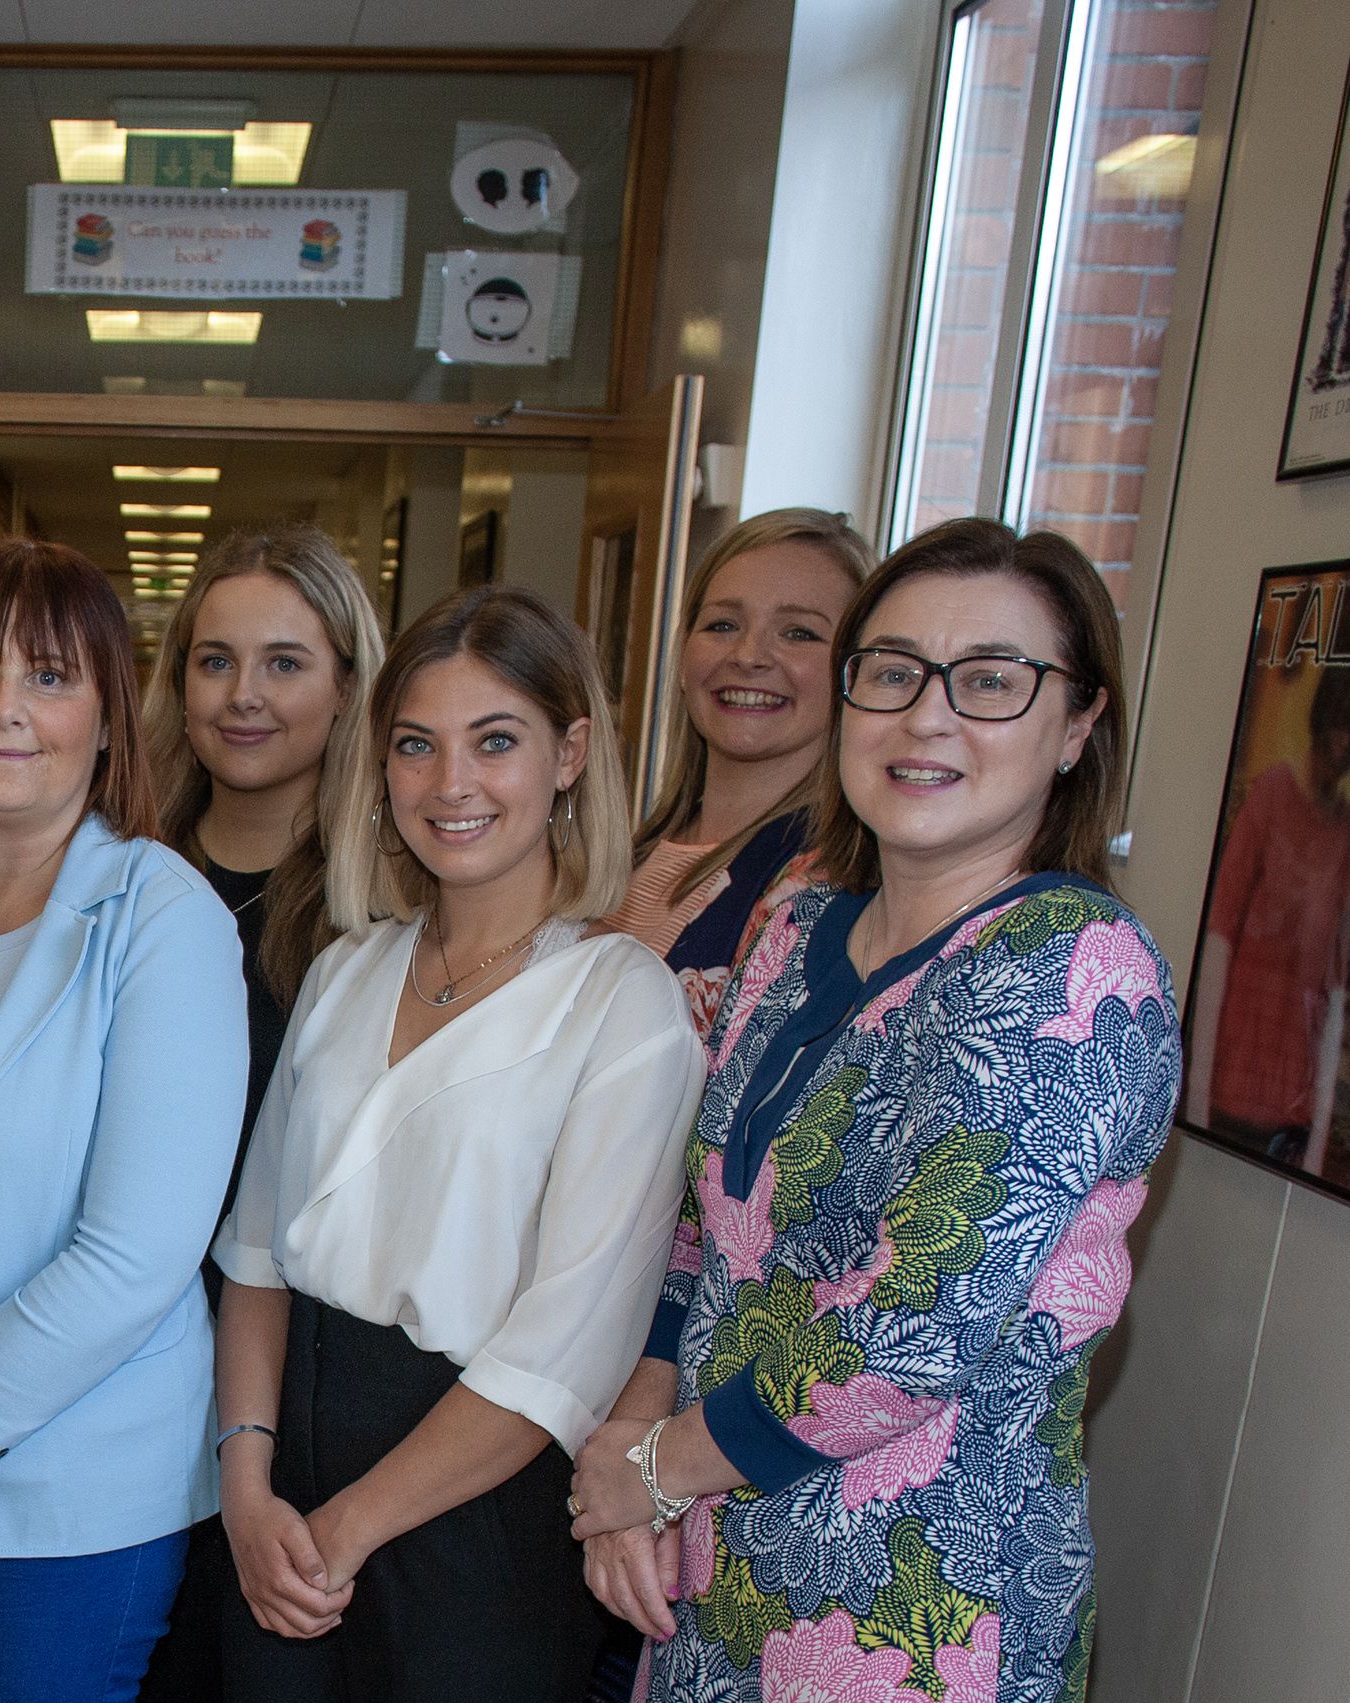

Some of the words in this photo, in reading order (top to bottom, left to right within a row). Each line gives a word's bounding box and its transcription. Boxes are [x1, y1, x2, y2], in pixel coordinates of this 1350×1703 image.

[127, 220, 162, 237] Can
[165, 226, 195, 239] you
[199, 226, 241, 241] guess
[244, 221, 273, 239] the
[174, 245, 224, 264] book?
[1308, 402, 1331, 421] THE
